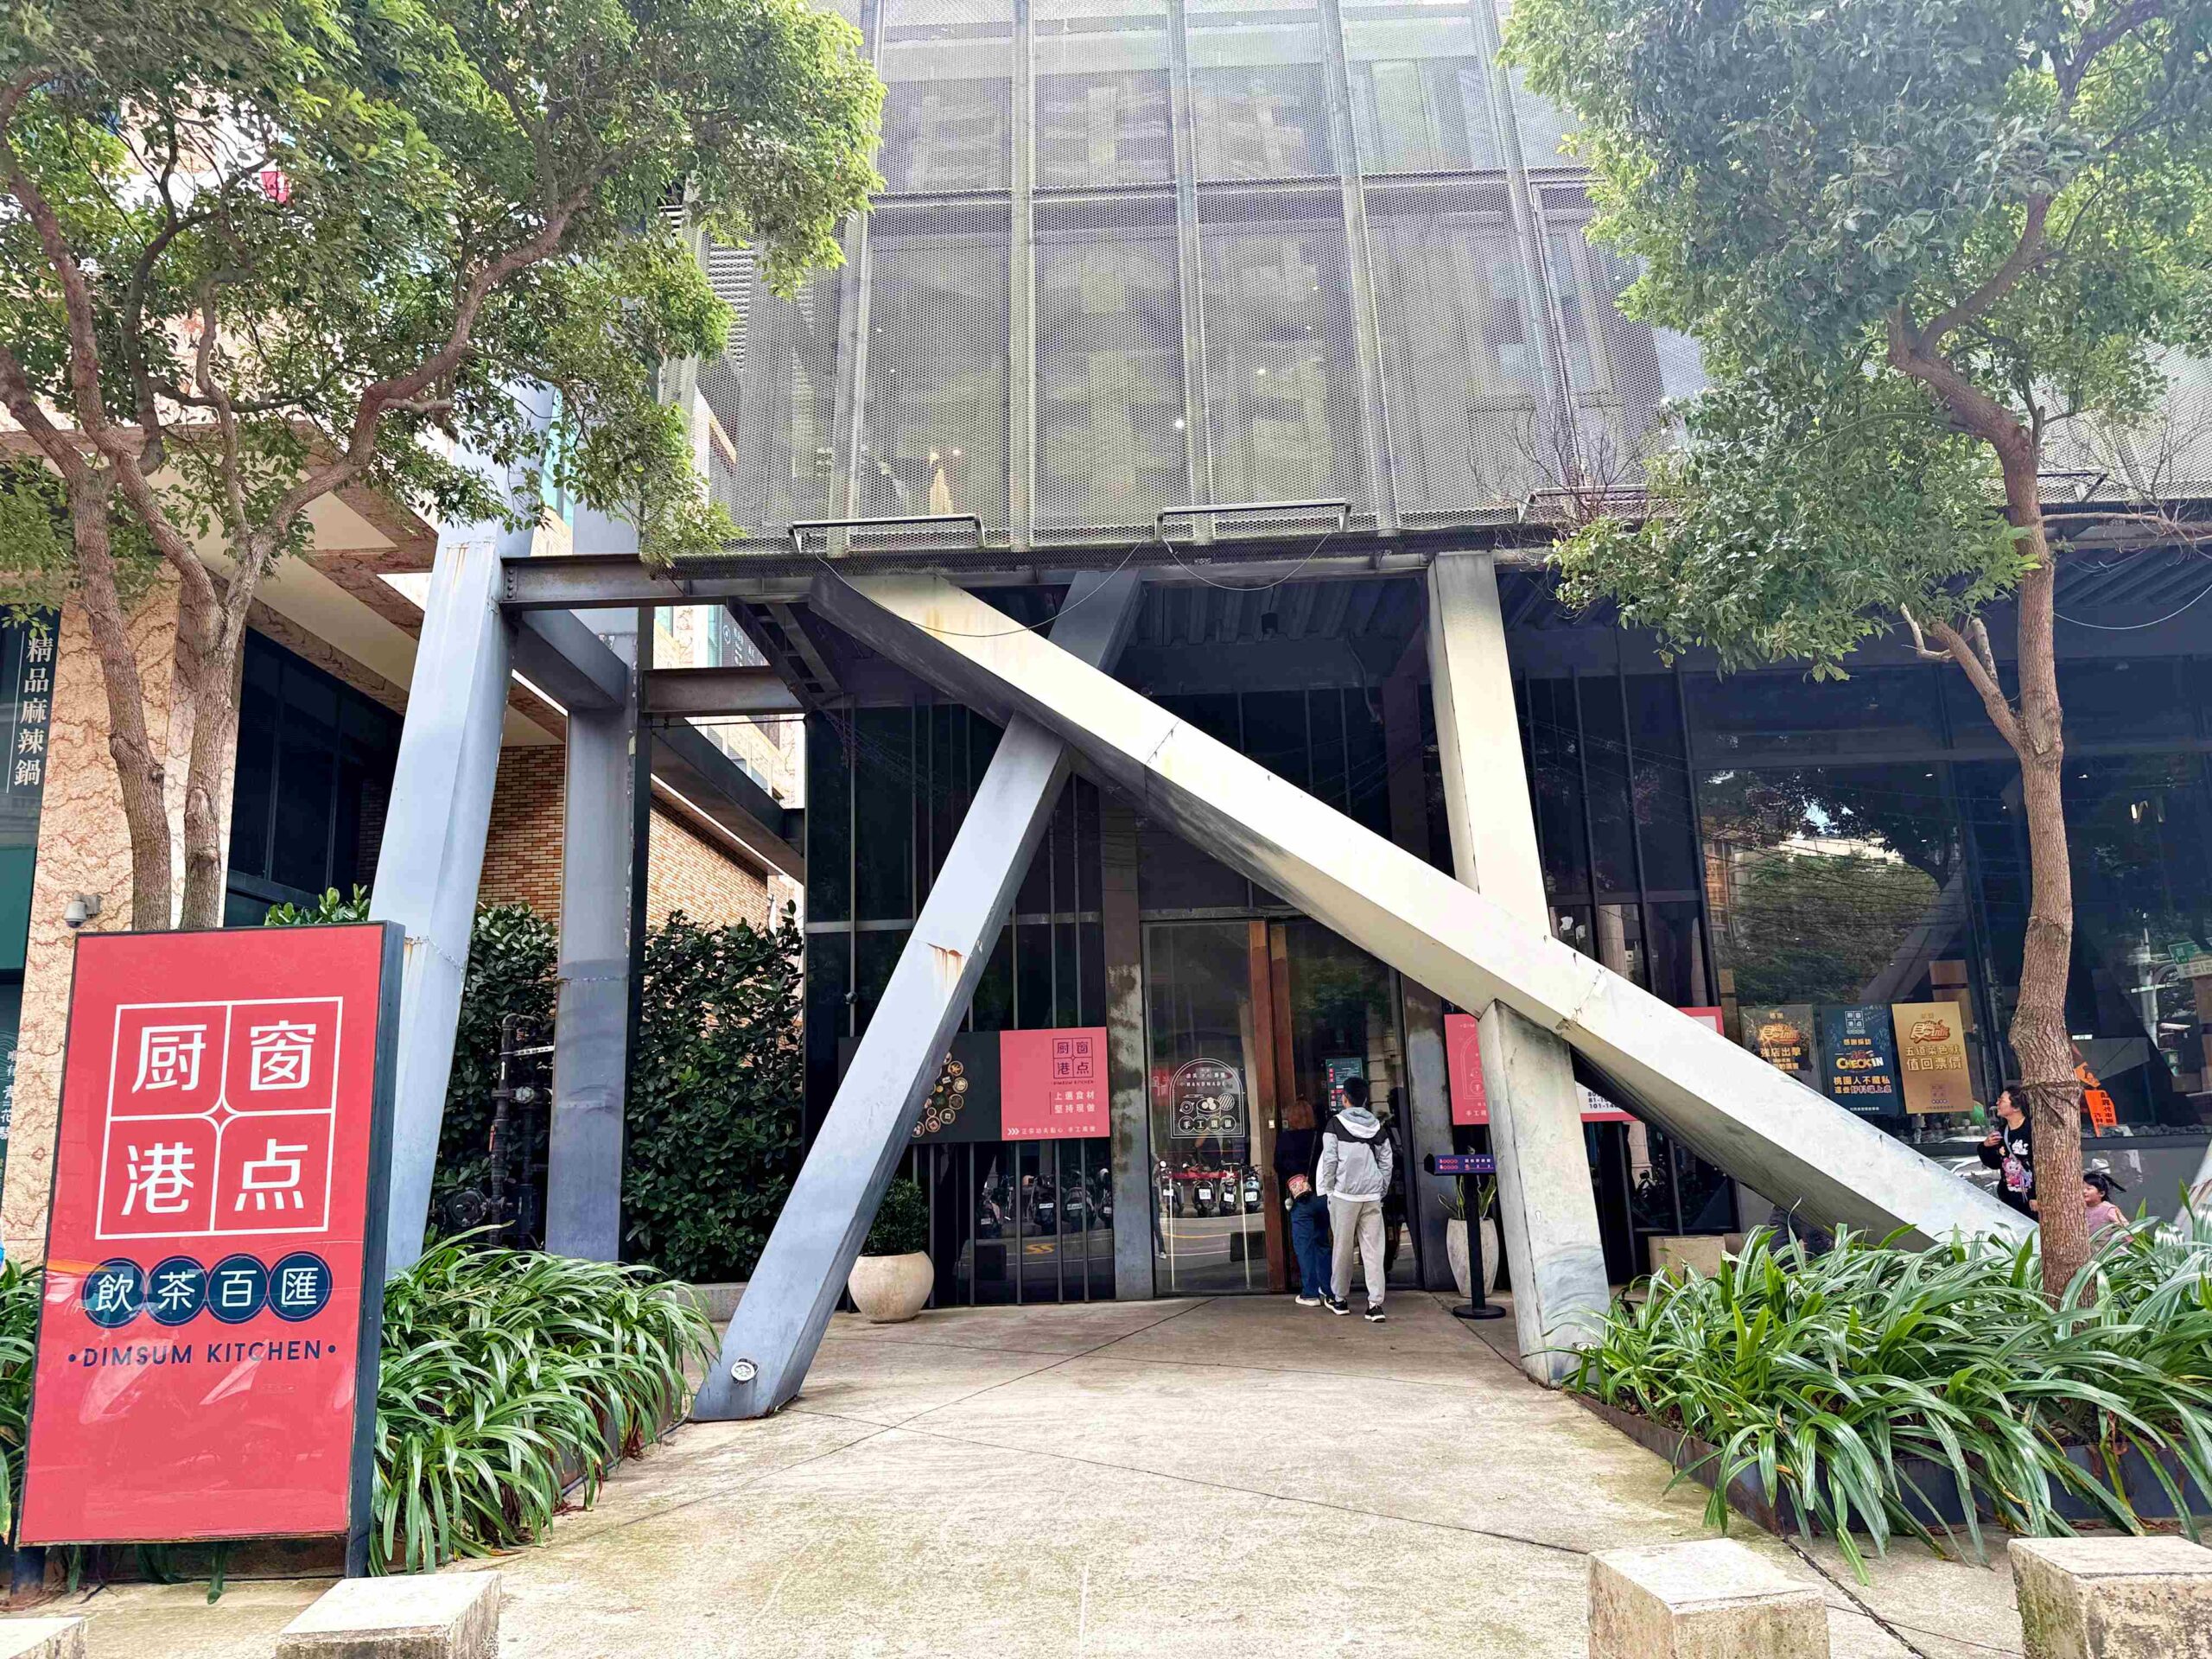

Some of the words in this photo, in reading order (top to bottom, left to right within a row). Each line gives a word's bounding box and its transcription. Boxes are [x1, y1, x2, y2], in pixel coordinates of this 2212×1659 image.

[14, 638, 54, 786] 精品麻辣鍋
[1906, 1056, 1963, 1071] 值回票價
[1054, 1090, 1095, 1100] 上選食材
[95, 1267, 320, 1313] 飲茶百匯
[83, 1344, 193, 1367] DIMSUM
[207, 1340, 321, 1363] KITCHEN
